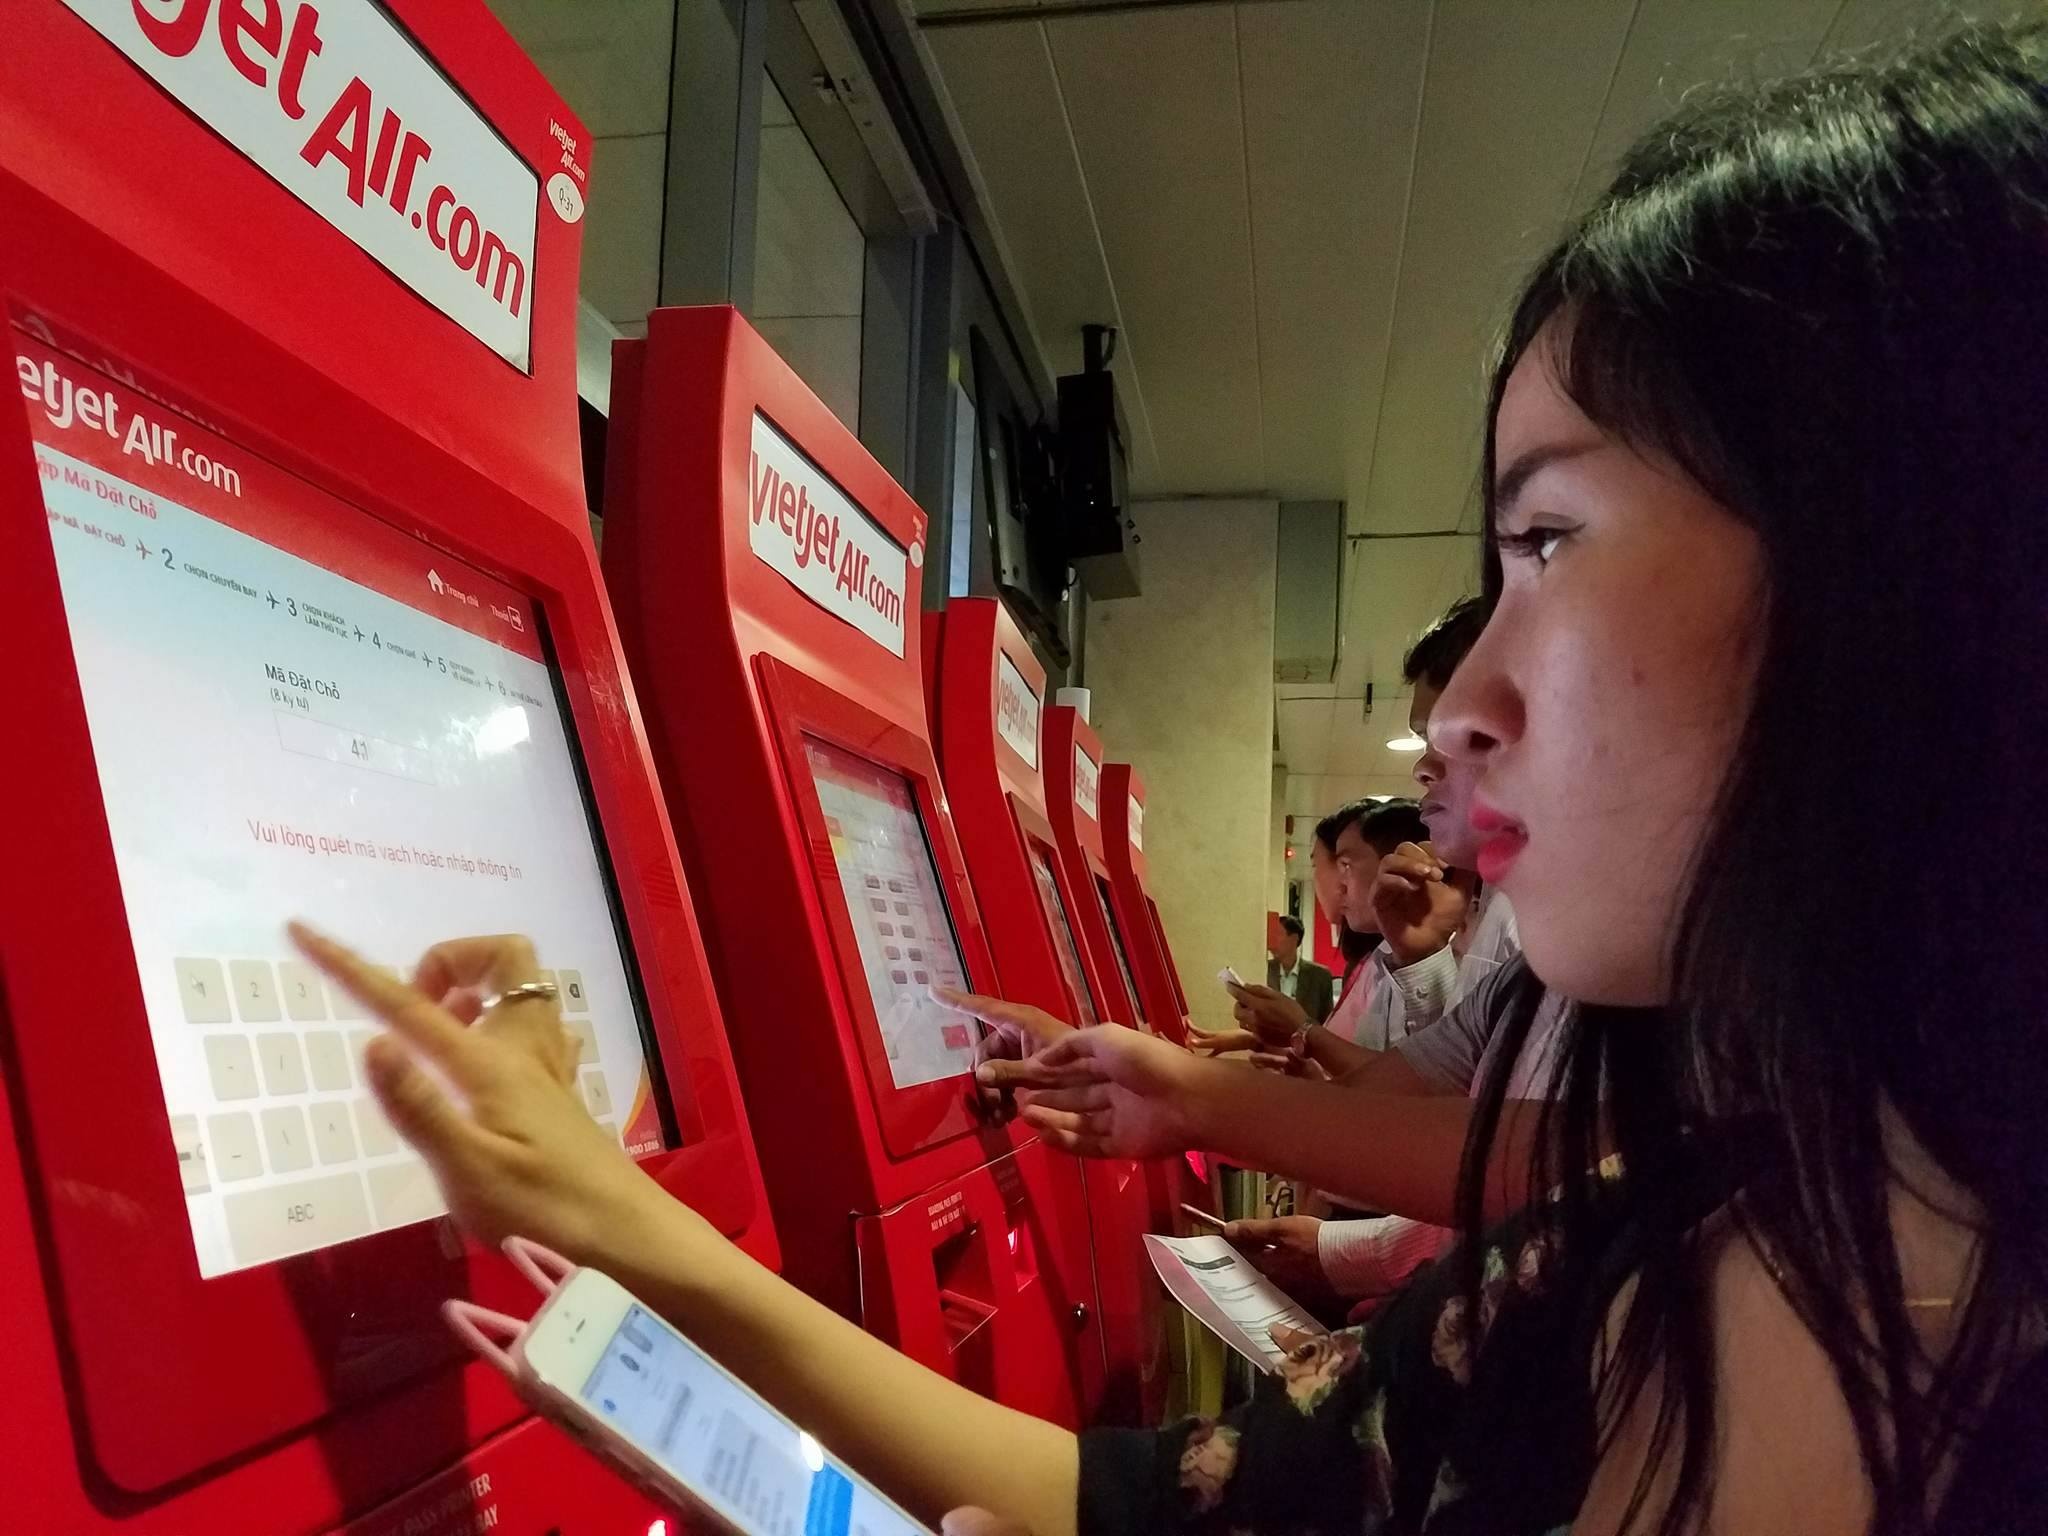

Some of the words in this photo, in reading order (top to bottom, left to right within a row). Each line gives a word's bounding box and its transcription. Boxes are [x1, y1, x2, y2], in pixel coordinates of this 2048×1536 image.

[161, 547, 176, 571] 2
[286, 597, 298, 617] 3
[372, 631, 382, 650] 4
[264, 662, 287, 684] Mã
[437, 656, 447, 674] 5
[246, 818, 278, 843] Vui
[249, 981, 261, 998] 2
[286, 1202, 316, 1224] ABC
